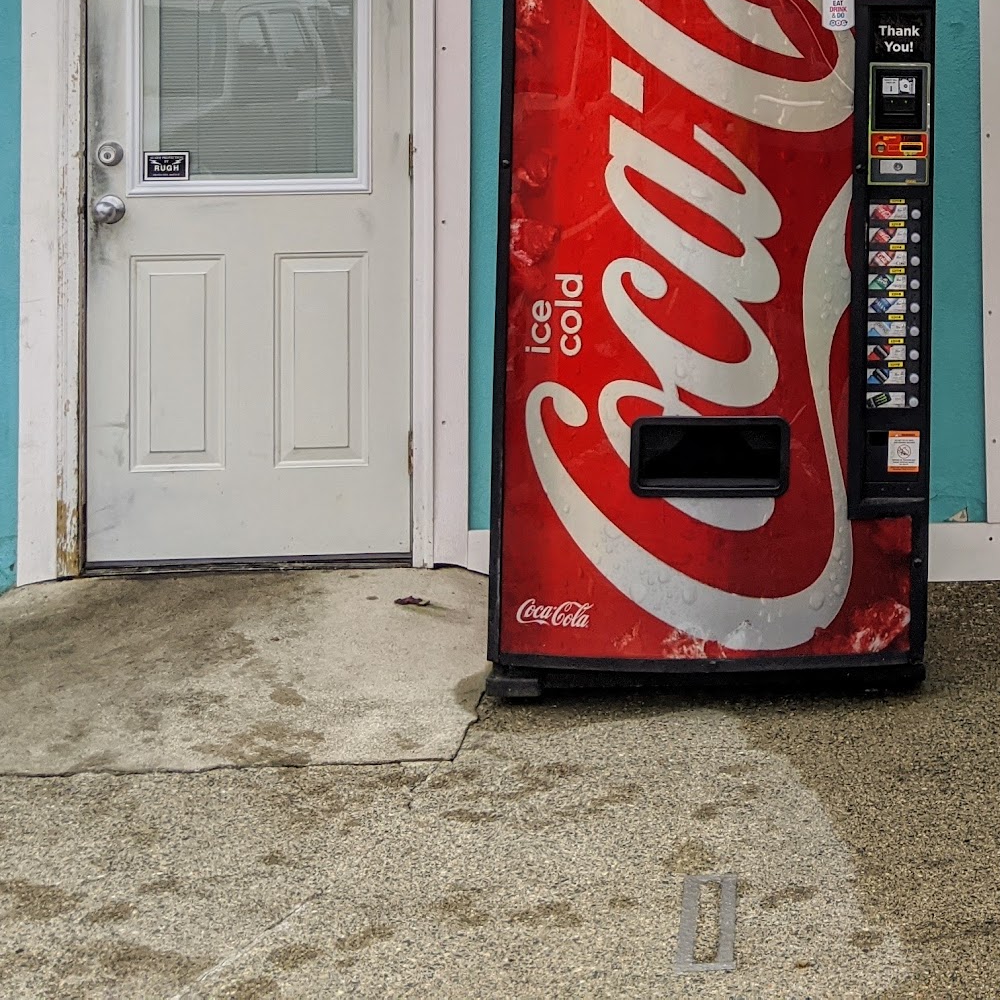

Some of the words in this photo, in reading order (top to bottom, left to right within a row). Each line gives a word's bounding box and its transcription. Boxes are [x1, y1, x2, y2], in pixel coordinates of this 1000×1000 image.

[878, 25, 920, 37] Thank
[884, 41, 913, 52] You!
[525, 300, 552, 354] ice
[554, 273, 584, 357] cold
